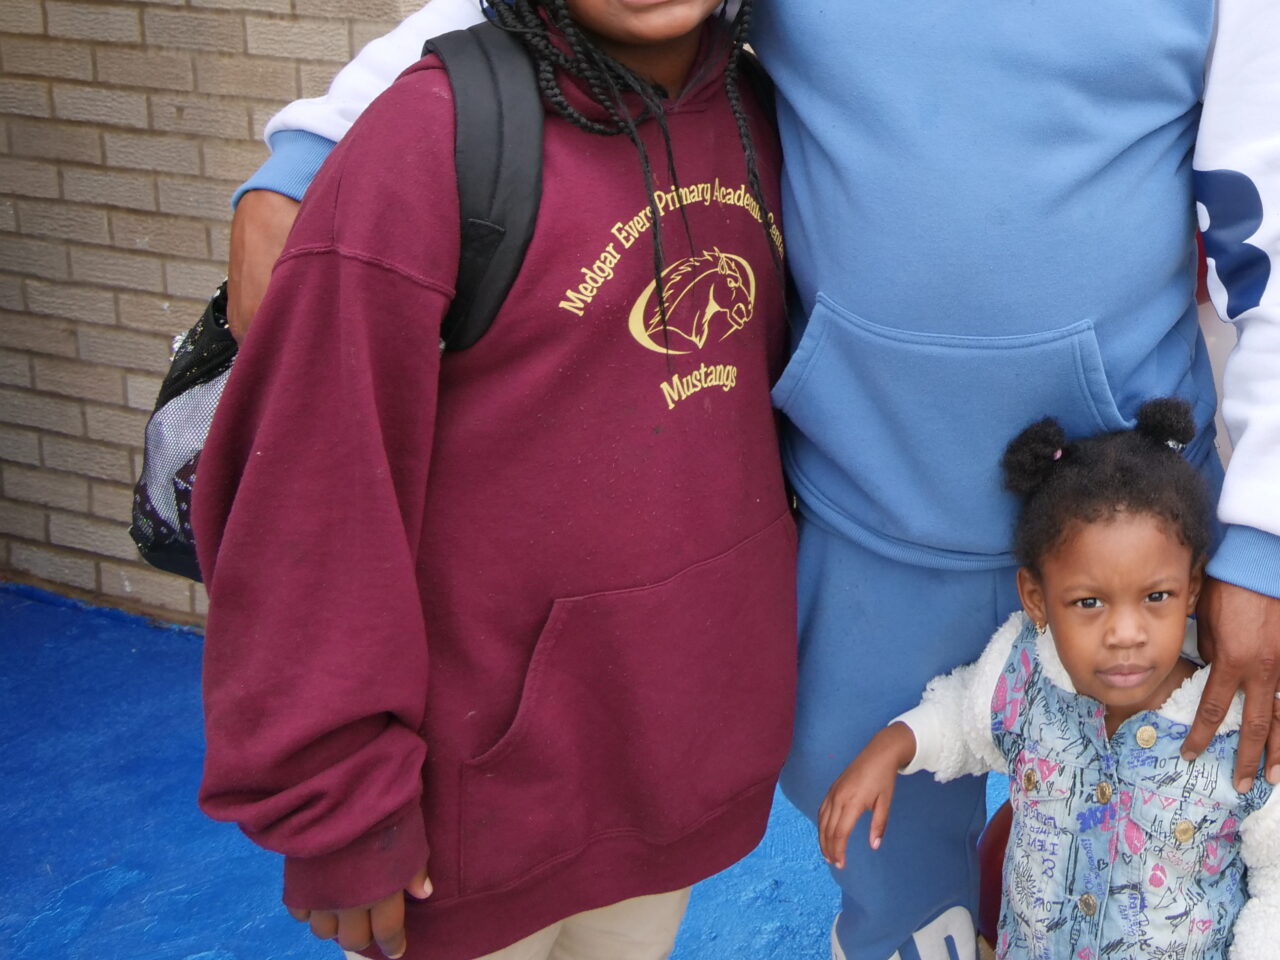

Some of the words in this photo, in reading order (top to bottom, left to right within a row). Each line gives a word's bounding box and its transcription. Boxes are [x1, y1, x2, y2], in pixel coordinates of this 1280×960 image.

[558, 242, 621, 317] Medgar
[653, 183, 711, 216] Primary
[660, 362, 737, 410] Mustangs
